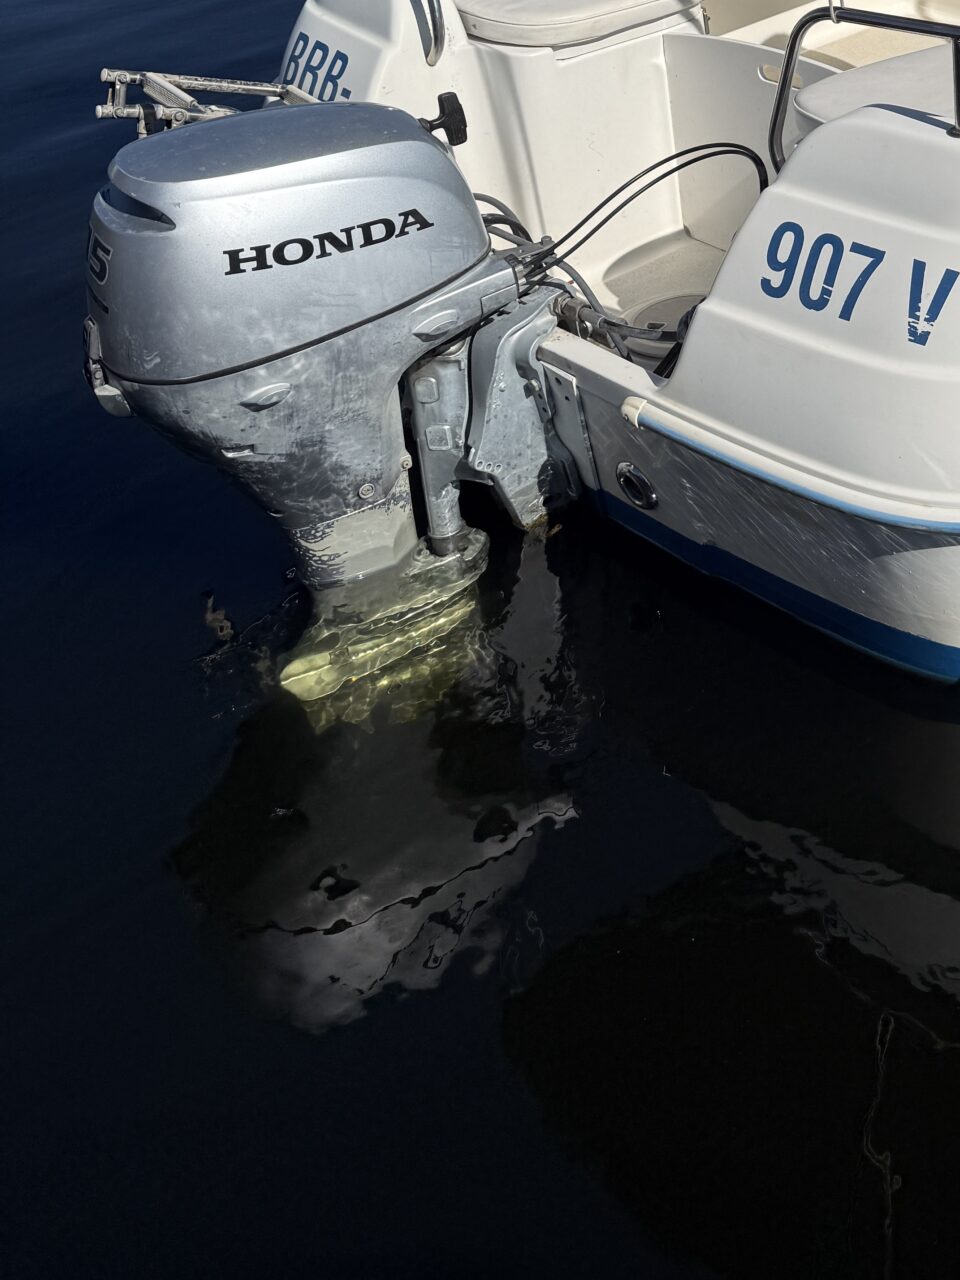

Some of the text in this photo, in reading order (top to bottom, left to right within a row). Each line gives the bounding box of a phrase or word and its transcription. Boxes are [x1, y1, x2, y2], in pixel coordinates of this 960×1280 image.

[222, 207, 435, 276] HONDA
[760, 220, 960, 347] 907 V
